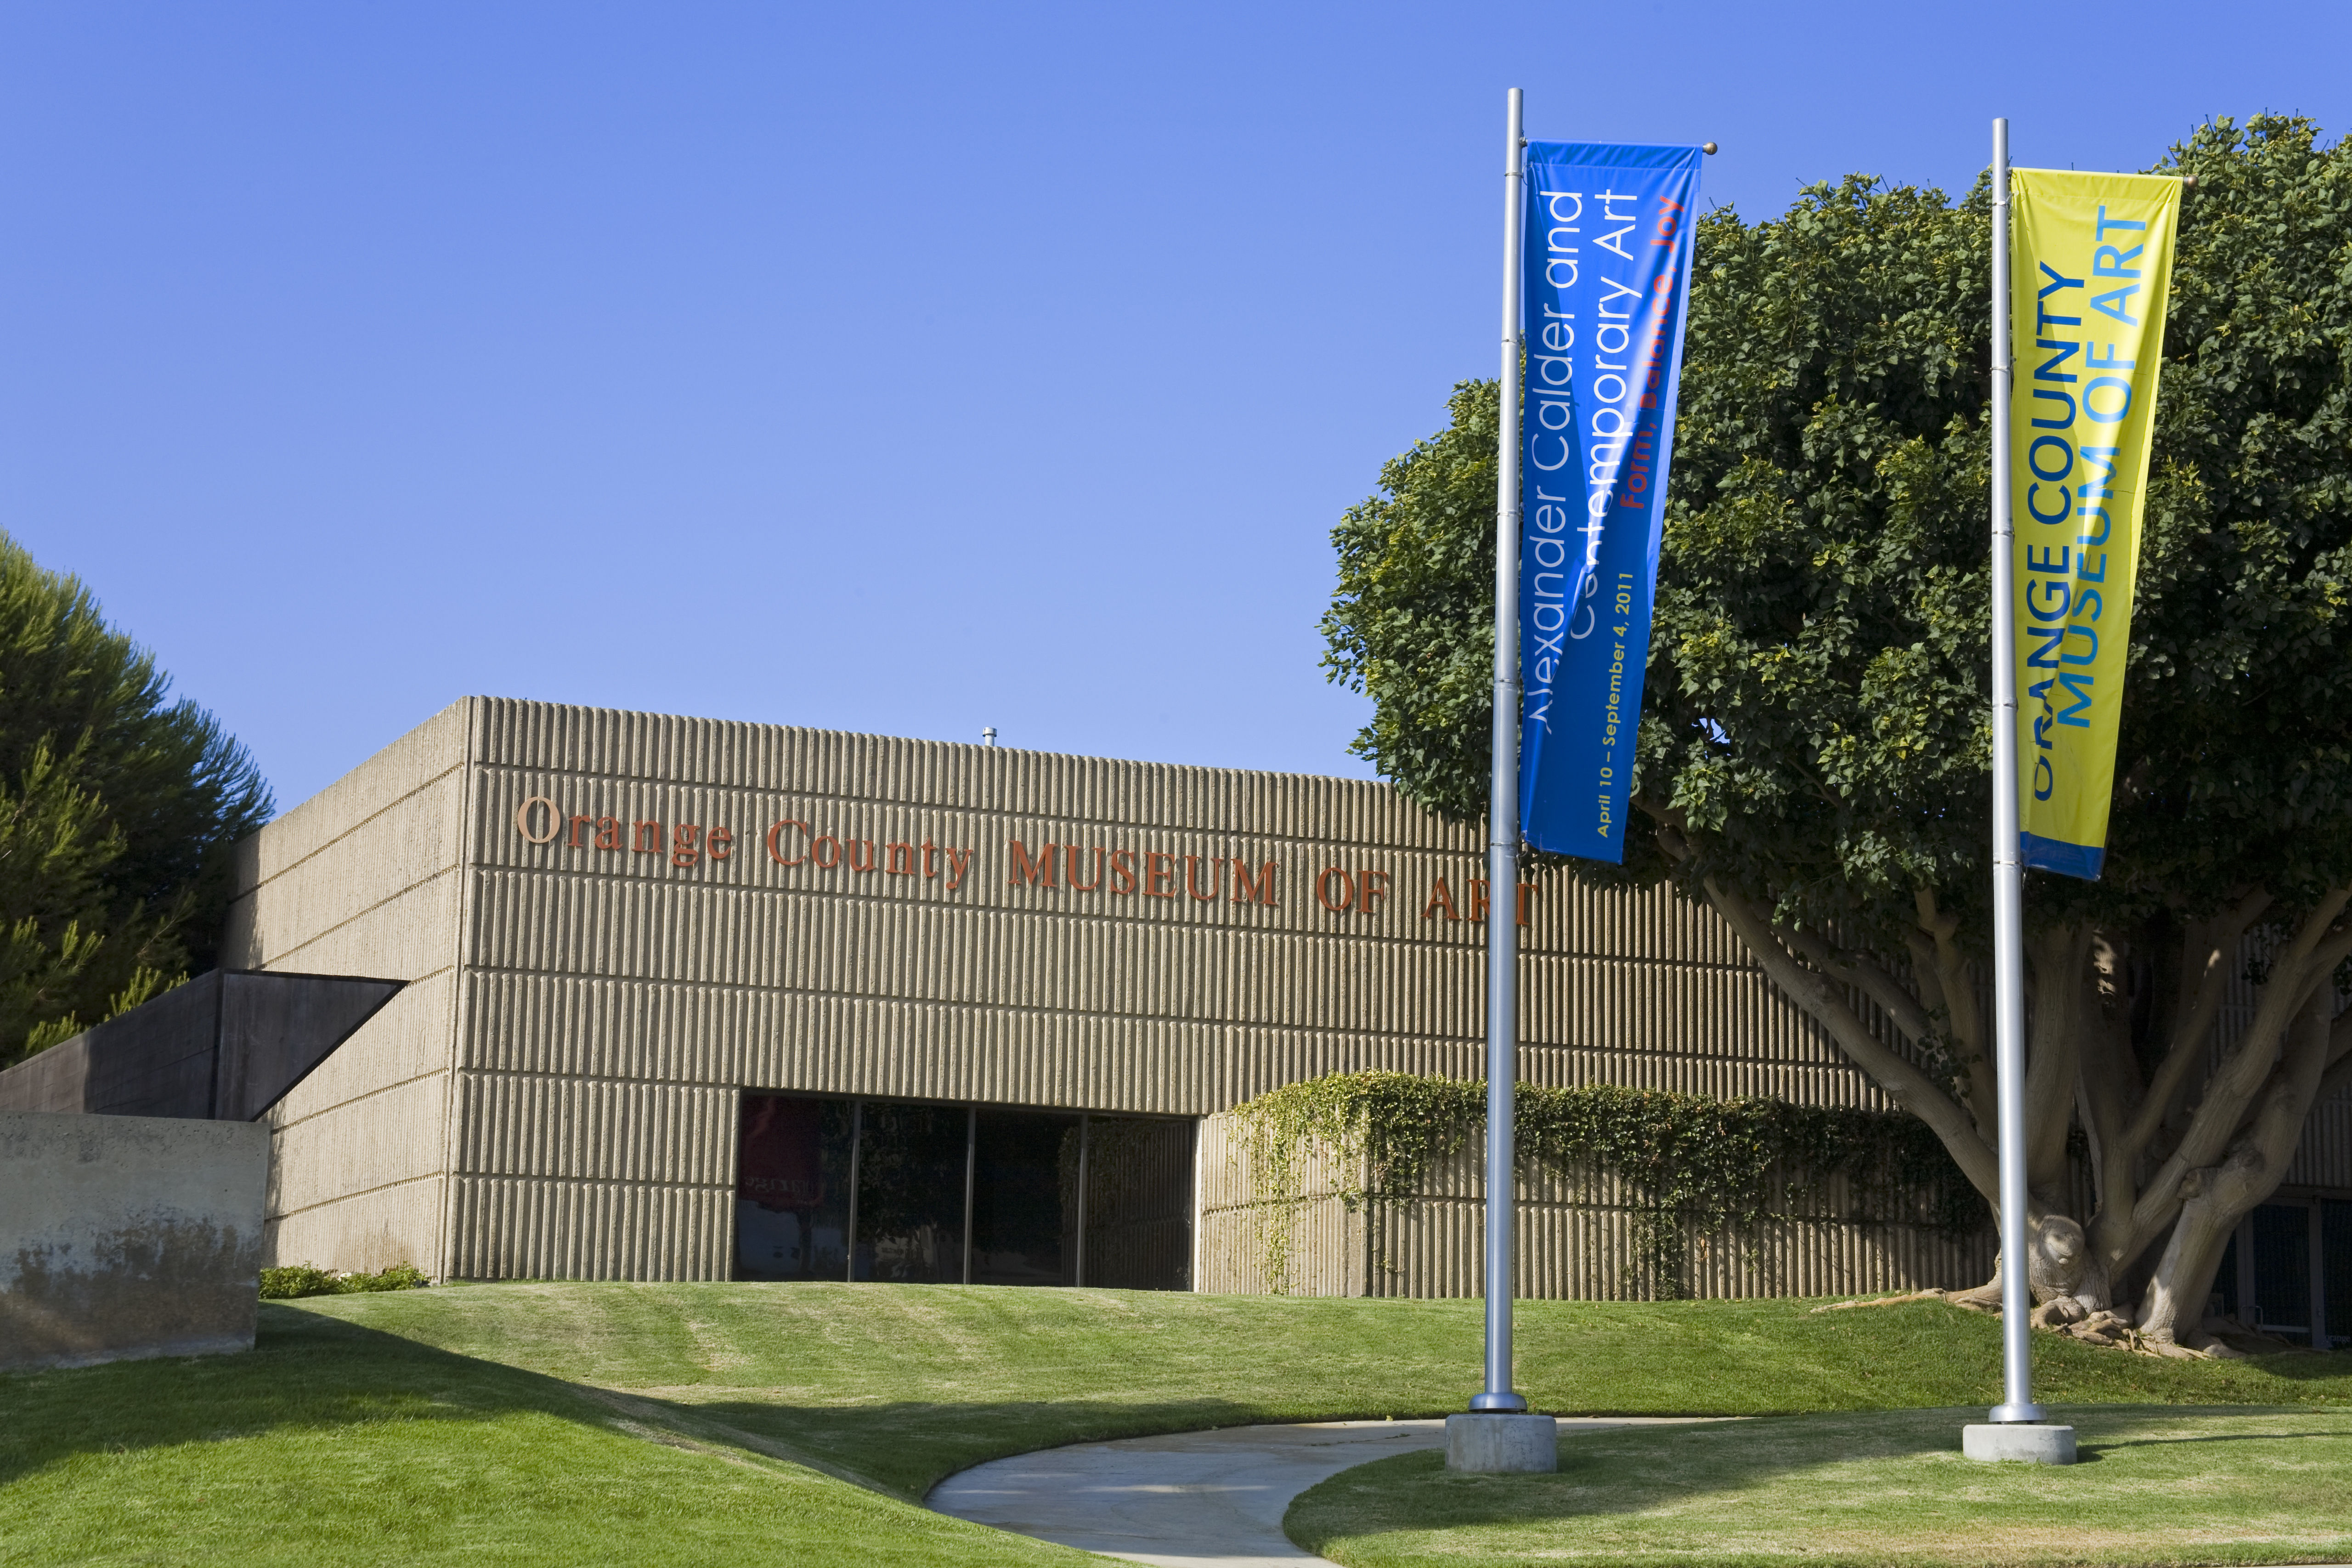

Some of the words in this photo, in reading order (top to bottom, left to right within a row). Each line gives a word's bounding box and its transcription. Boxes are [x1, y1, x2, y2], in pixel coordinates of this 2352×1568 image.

[1540, 191, 1582, 289] and
[1592, 188, 1638, 260] Art
[1650, 195, 1685, 254] Joy
[2090, 205, 2147, 327] ART
[1532, 303, 1575, 471] Calder
[1640, 266, 1677, 408] Balance,
[2082, 341, 2136, 424] OF
[2027, 260, 2085, 525] COUNTY
[1620, 423, 1657, 509] Form,
[1527, 485, 1566, 735] Alexander
[1613, 622, 1629, 637] 4,
[1615, 573, 1633, 615] 2011
[2057, 446, 2121, 728] MUSEUM
[1602, 641, 1625, 746] September
[2026, 544, 2071, 802] ORANGE
[1597, 795, 1612, 838] April
[1600, 767, 1613, 787] 10
[516, 796, 733, 868] Orange
[766, 819, 974, 890] County
[1008, 839, 1278, 906] MUSEUM
[1317, 866, 1389, 913] OF
[1421, 876, 1538, 925] ART
